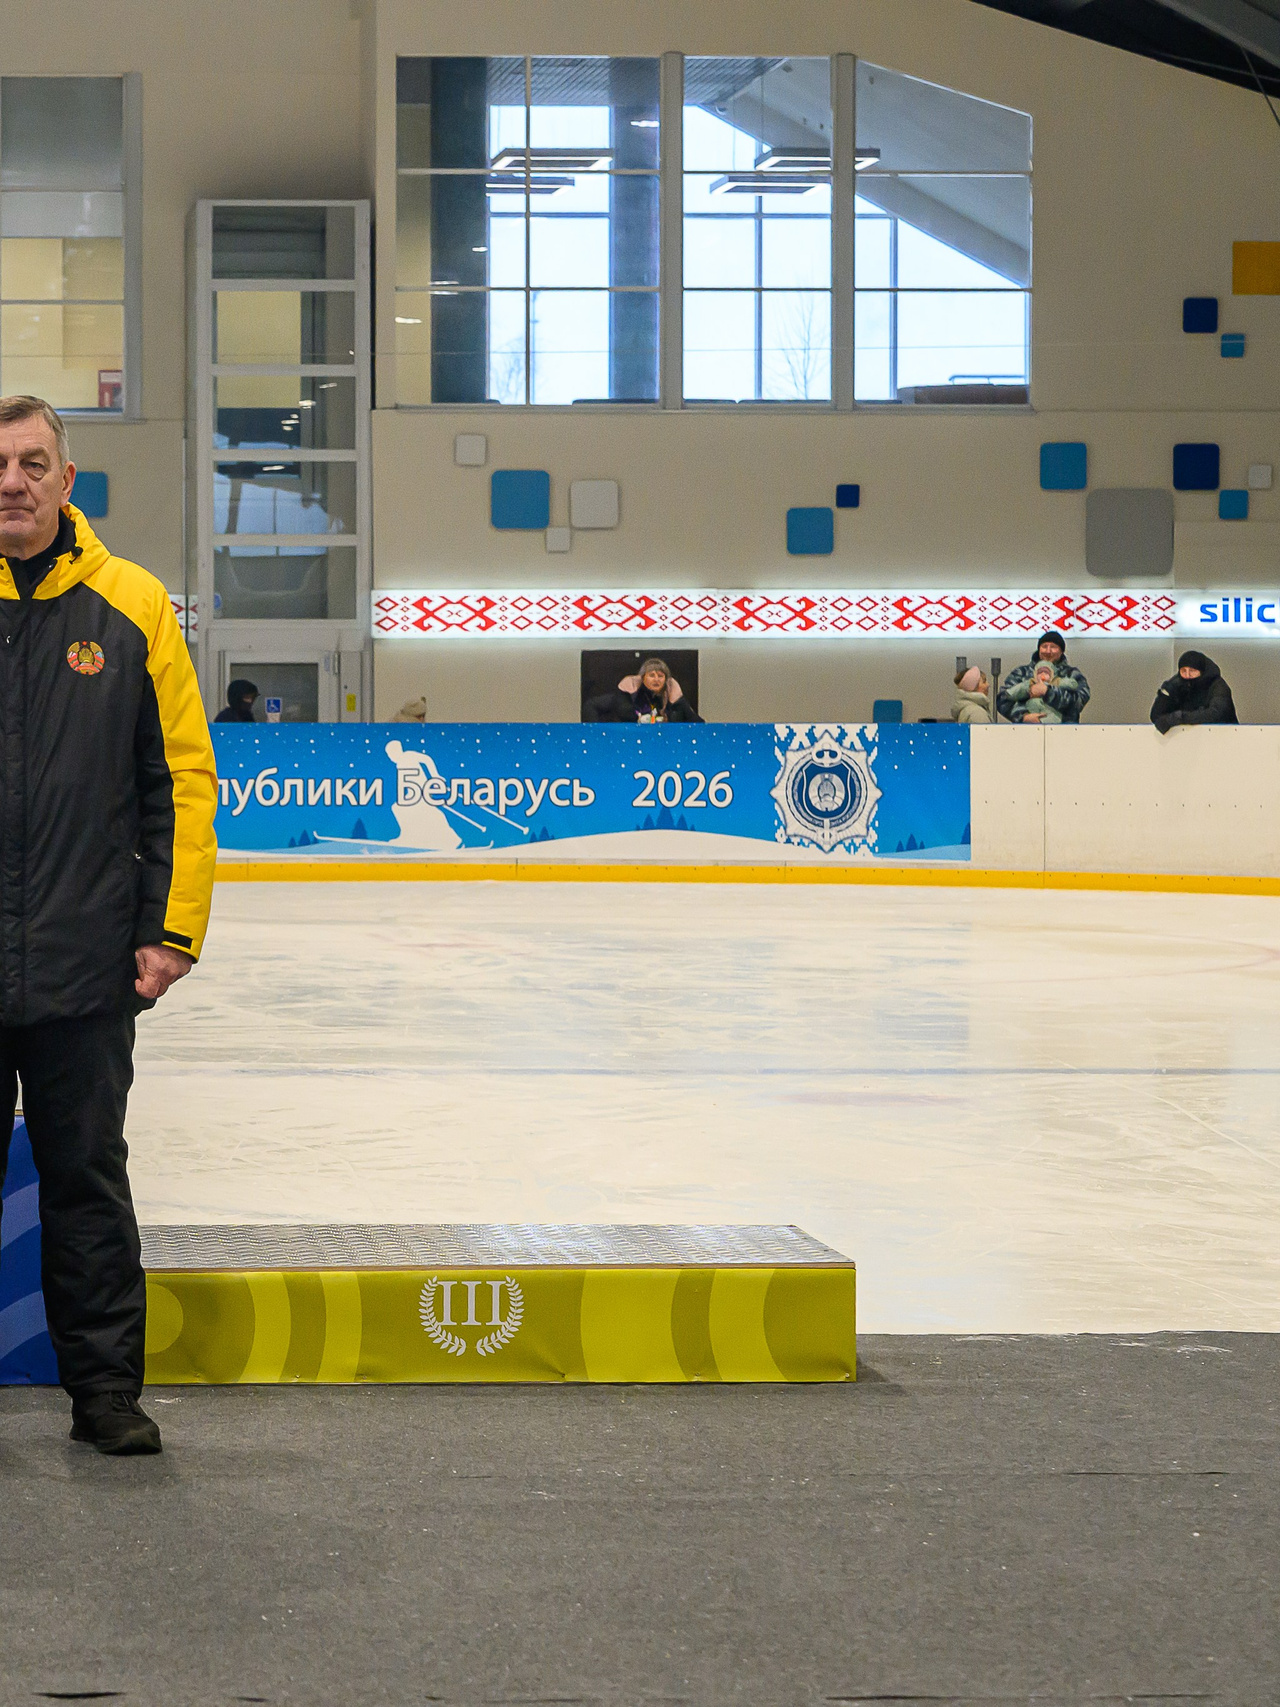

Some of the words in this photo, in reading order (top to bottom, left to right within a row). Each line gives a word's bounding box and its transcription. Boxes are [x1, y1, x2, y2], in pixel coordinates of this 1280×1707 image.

[1199, 596, 1276, 624] silic
[396, 767, 596, 817] Беларусь
[631, 770, 735, 808] 2026
[436, 1280, 507, 1326] III
